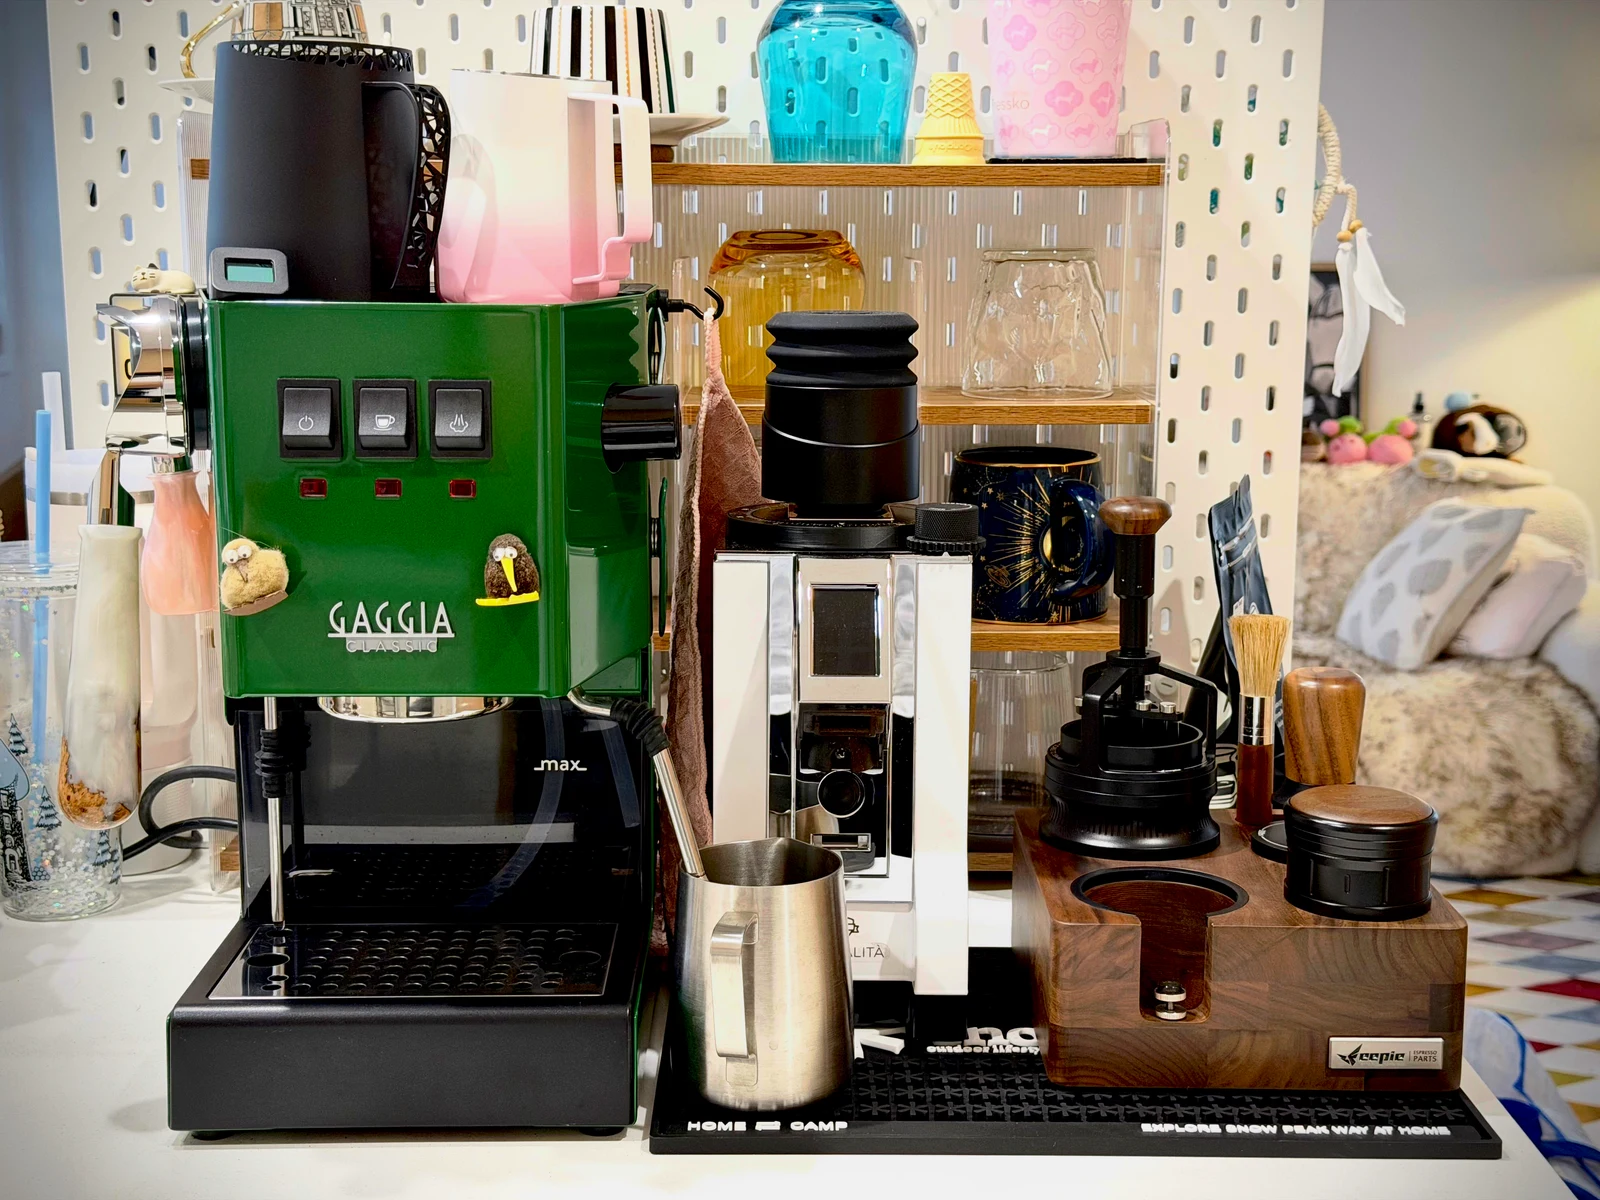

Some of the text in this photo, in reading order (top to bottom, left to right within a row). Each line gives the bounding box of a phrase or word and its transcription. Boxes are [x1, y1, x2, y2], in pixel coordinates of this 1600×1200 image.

[328, 601, 455, 636] GAGGIA
[346, 640, 438, 653] CLASSIC
[539, 759, 582, 771] max
[851, 944, 885, 958] LITÀ
[926, 1045, 990, 1053] outdoor
[1413, 1055, 1438, 1063] PARTS
[687, 1121, 848, 1131] HOME CAMP
[1141, 1123, 1451, 1136] EXPLORE SNOW PEAK WAY AT HOME
